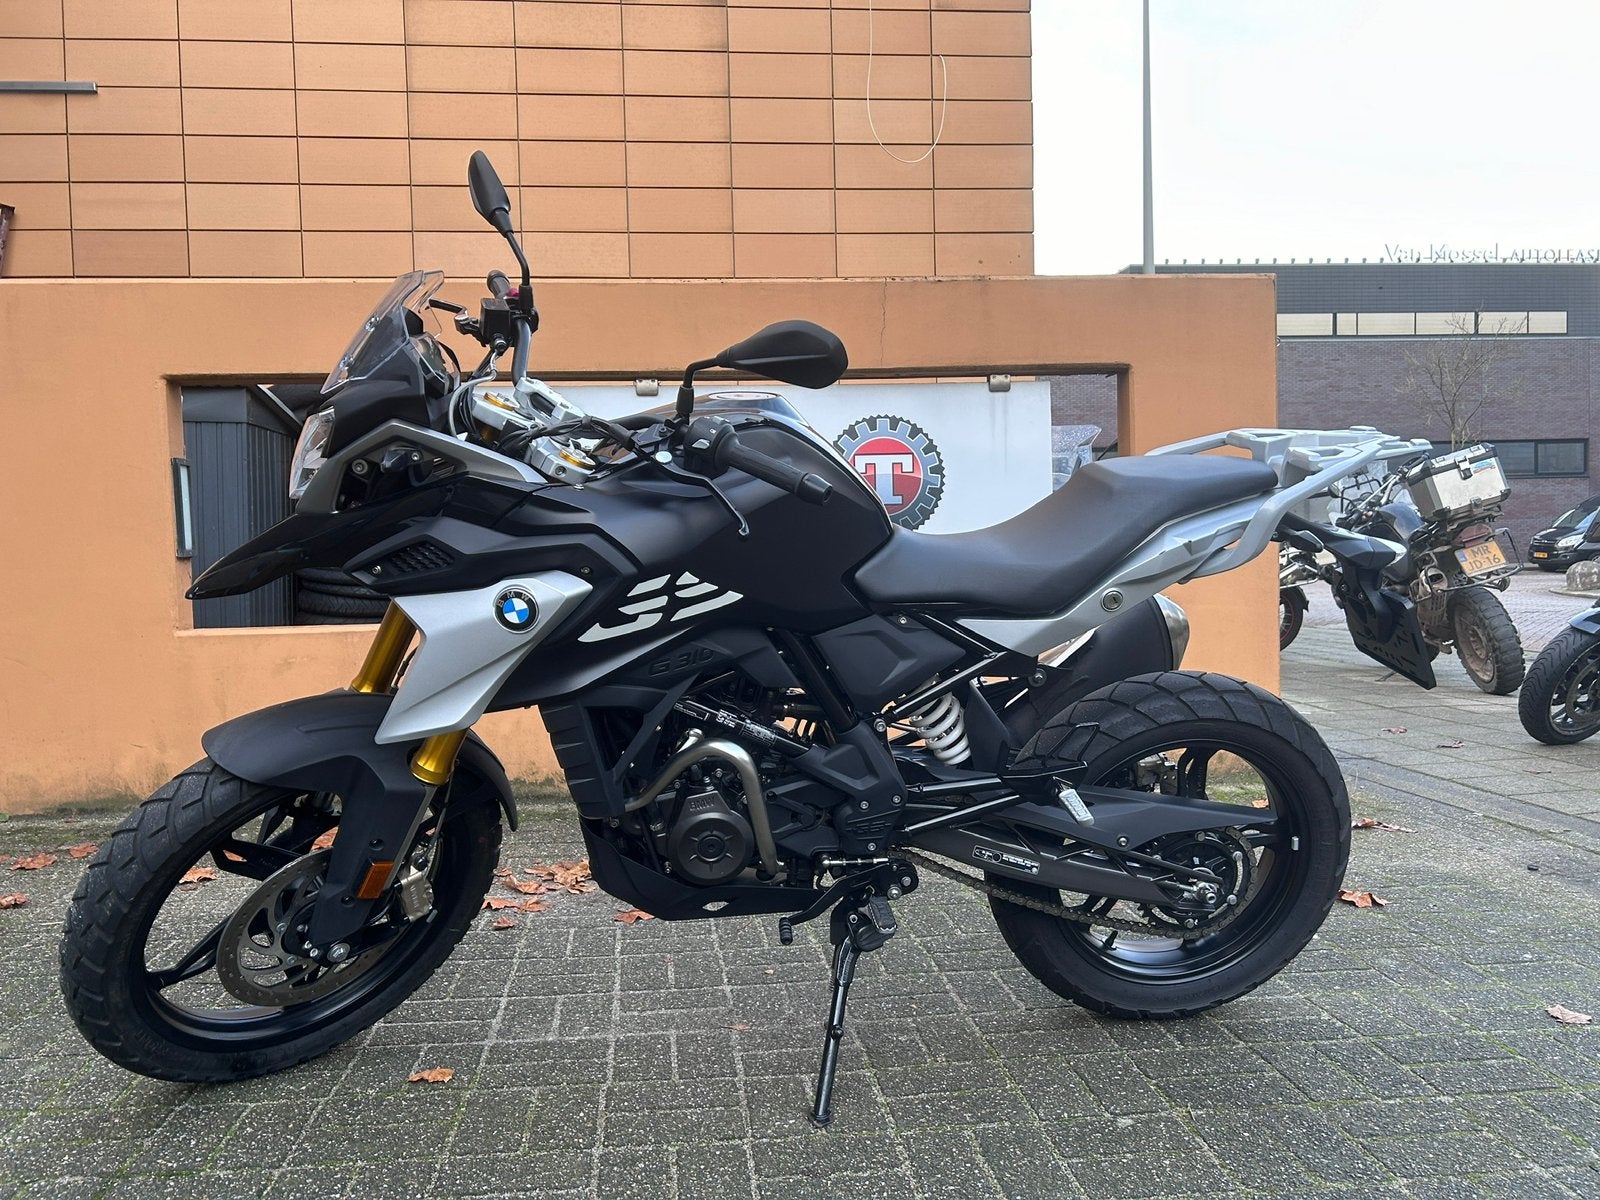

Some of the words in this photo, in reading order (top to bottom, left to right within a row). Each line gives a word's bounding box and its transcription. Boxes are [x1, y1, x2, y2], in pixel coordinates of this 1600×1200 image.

[854, 453, 914, 505] T
[1471, 544, 1491, 558] MR
[1469, 553, 1501, 571] JD-16
[497, 591, 530, 607] BMW
